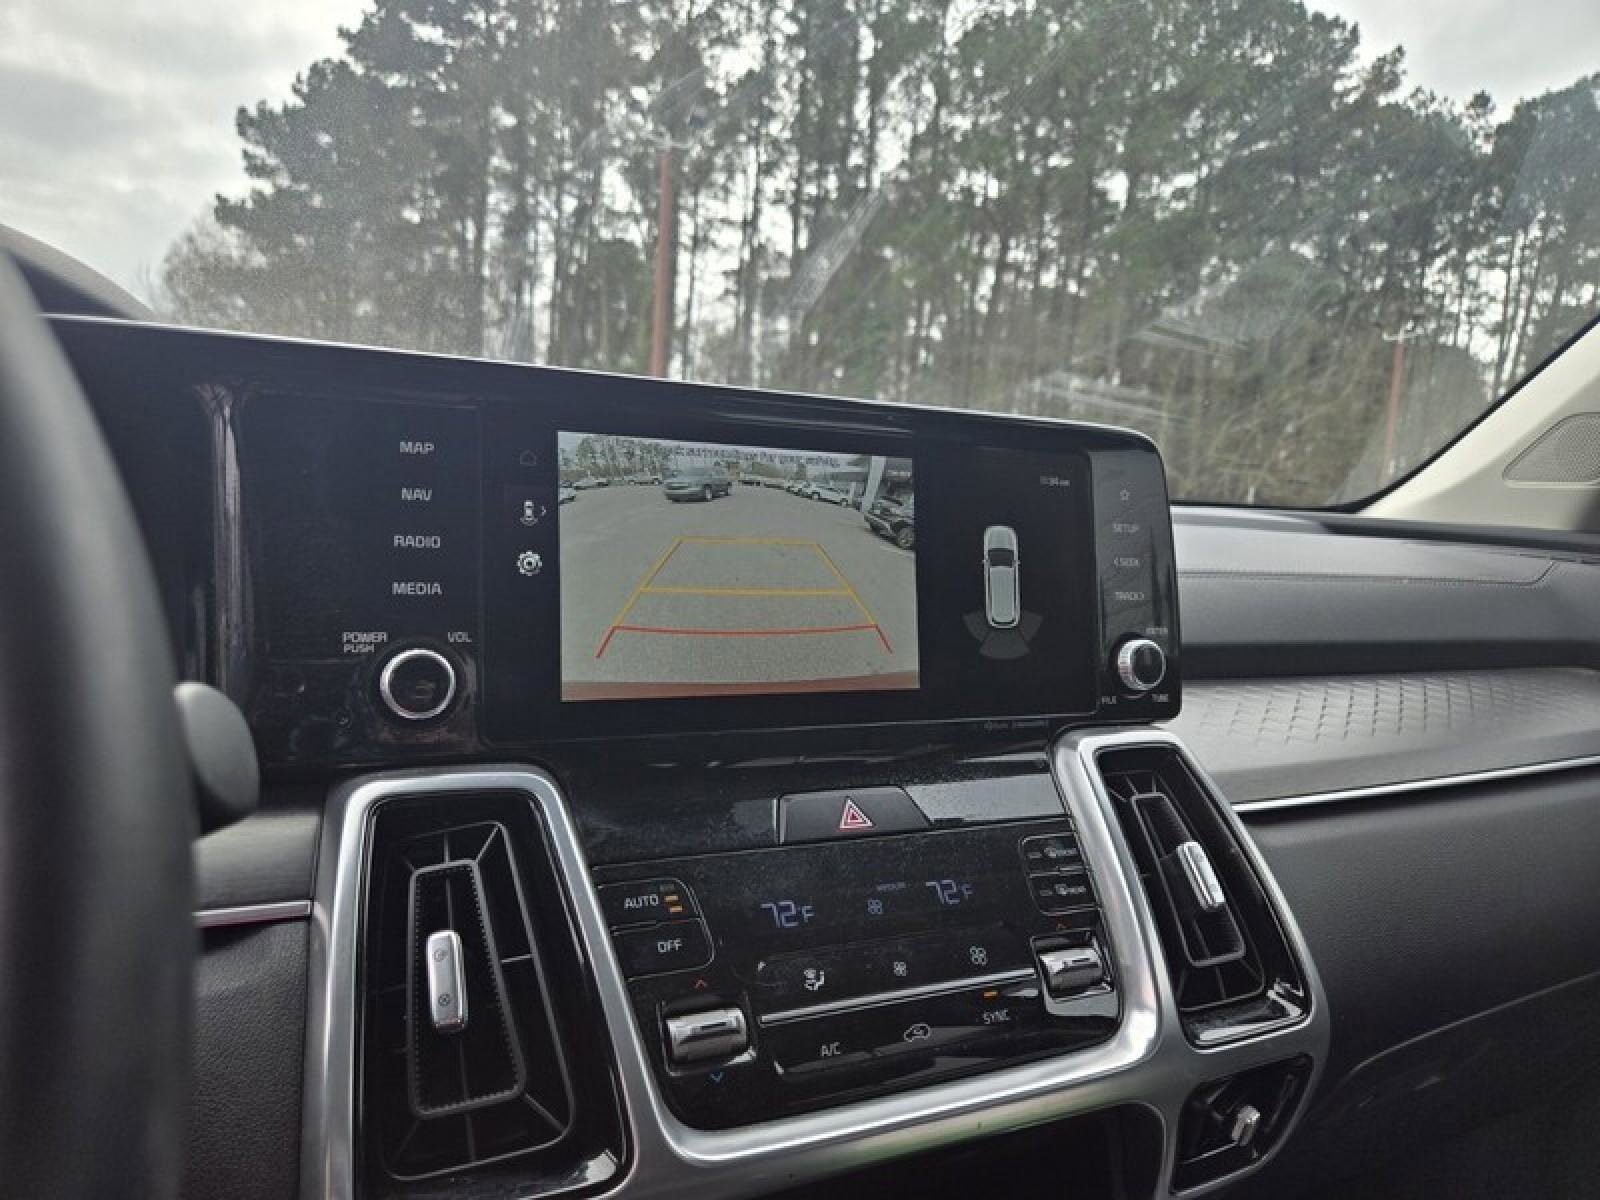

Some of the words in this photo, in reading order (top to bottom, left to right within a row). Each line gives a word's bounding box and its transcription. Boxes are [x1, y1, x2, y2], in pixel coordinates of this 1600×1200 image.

[399, 441, 435, 454] MAP
[401, 488, 433, 501] NAV
[393, 535, 441, 549] RADIO
[392, 582, 442, 595] MEDIA
[342, 631, 387, 643] POWER
[447, 631, 472, 643] VOL
[343, 643, 375, 653] PUSH
[624, 894, 659, 910] AUTO
[657, 938, 682, 953] OFF
[820, 1041, 841, 1057] A/C
